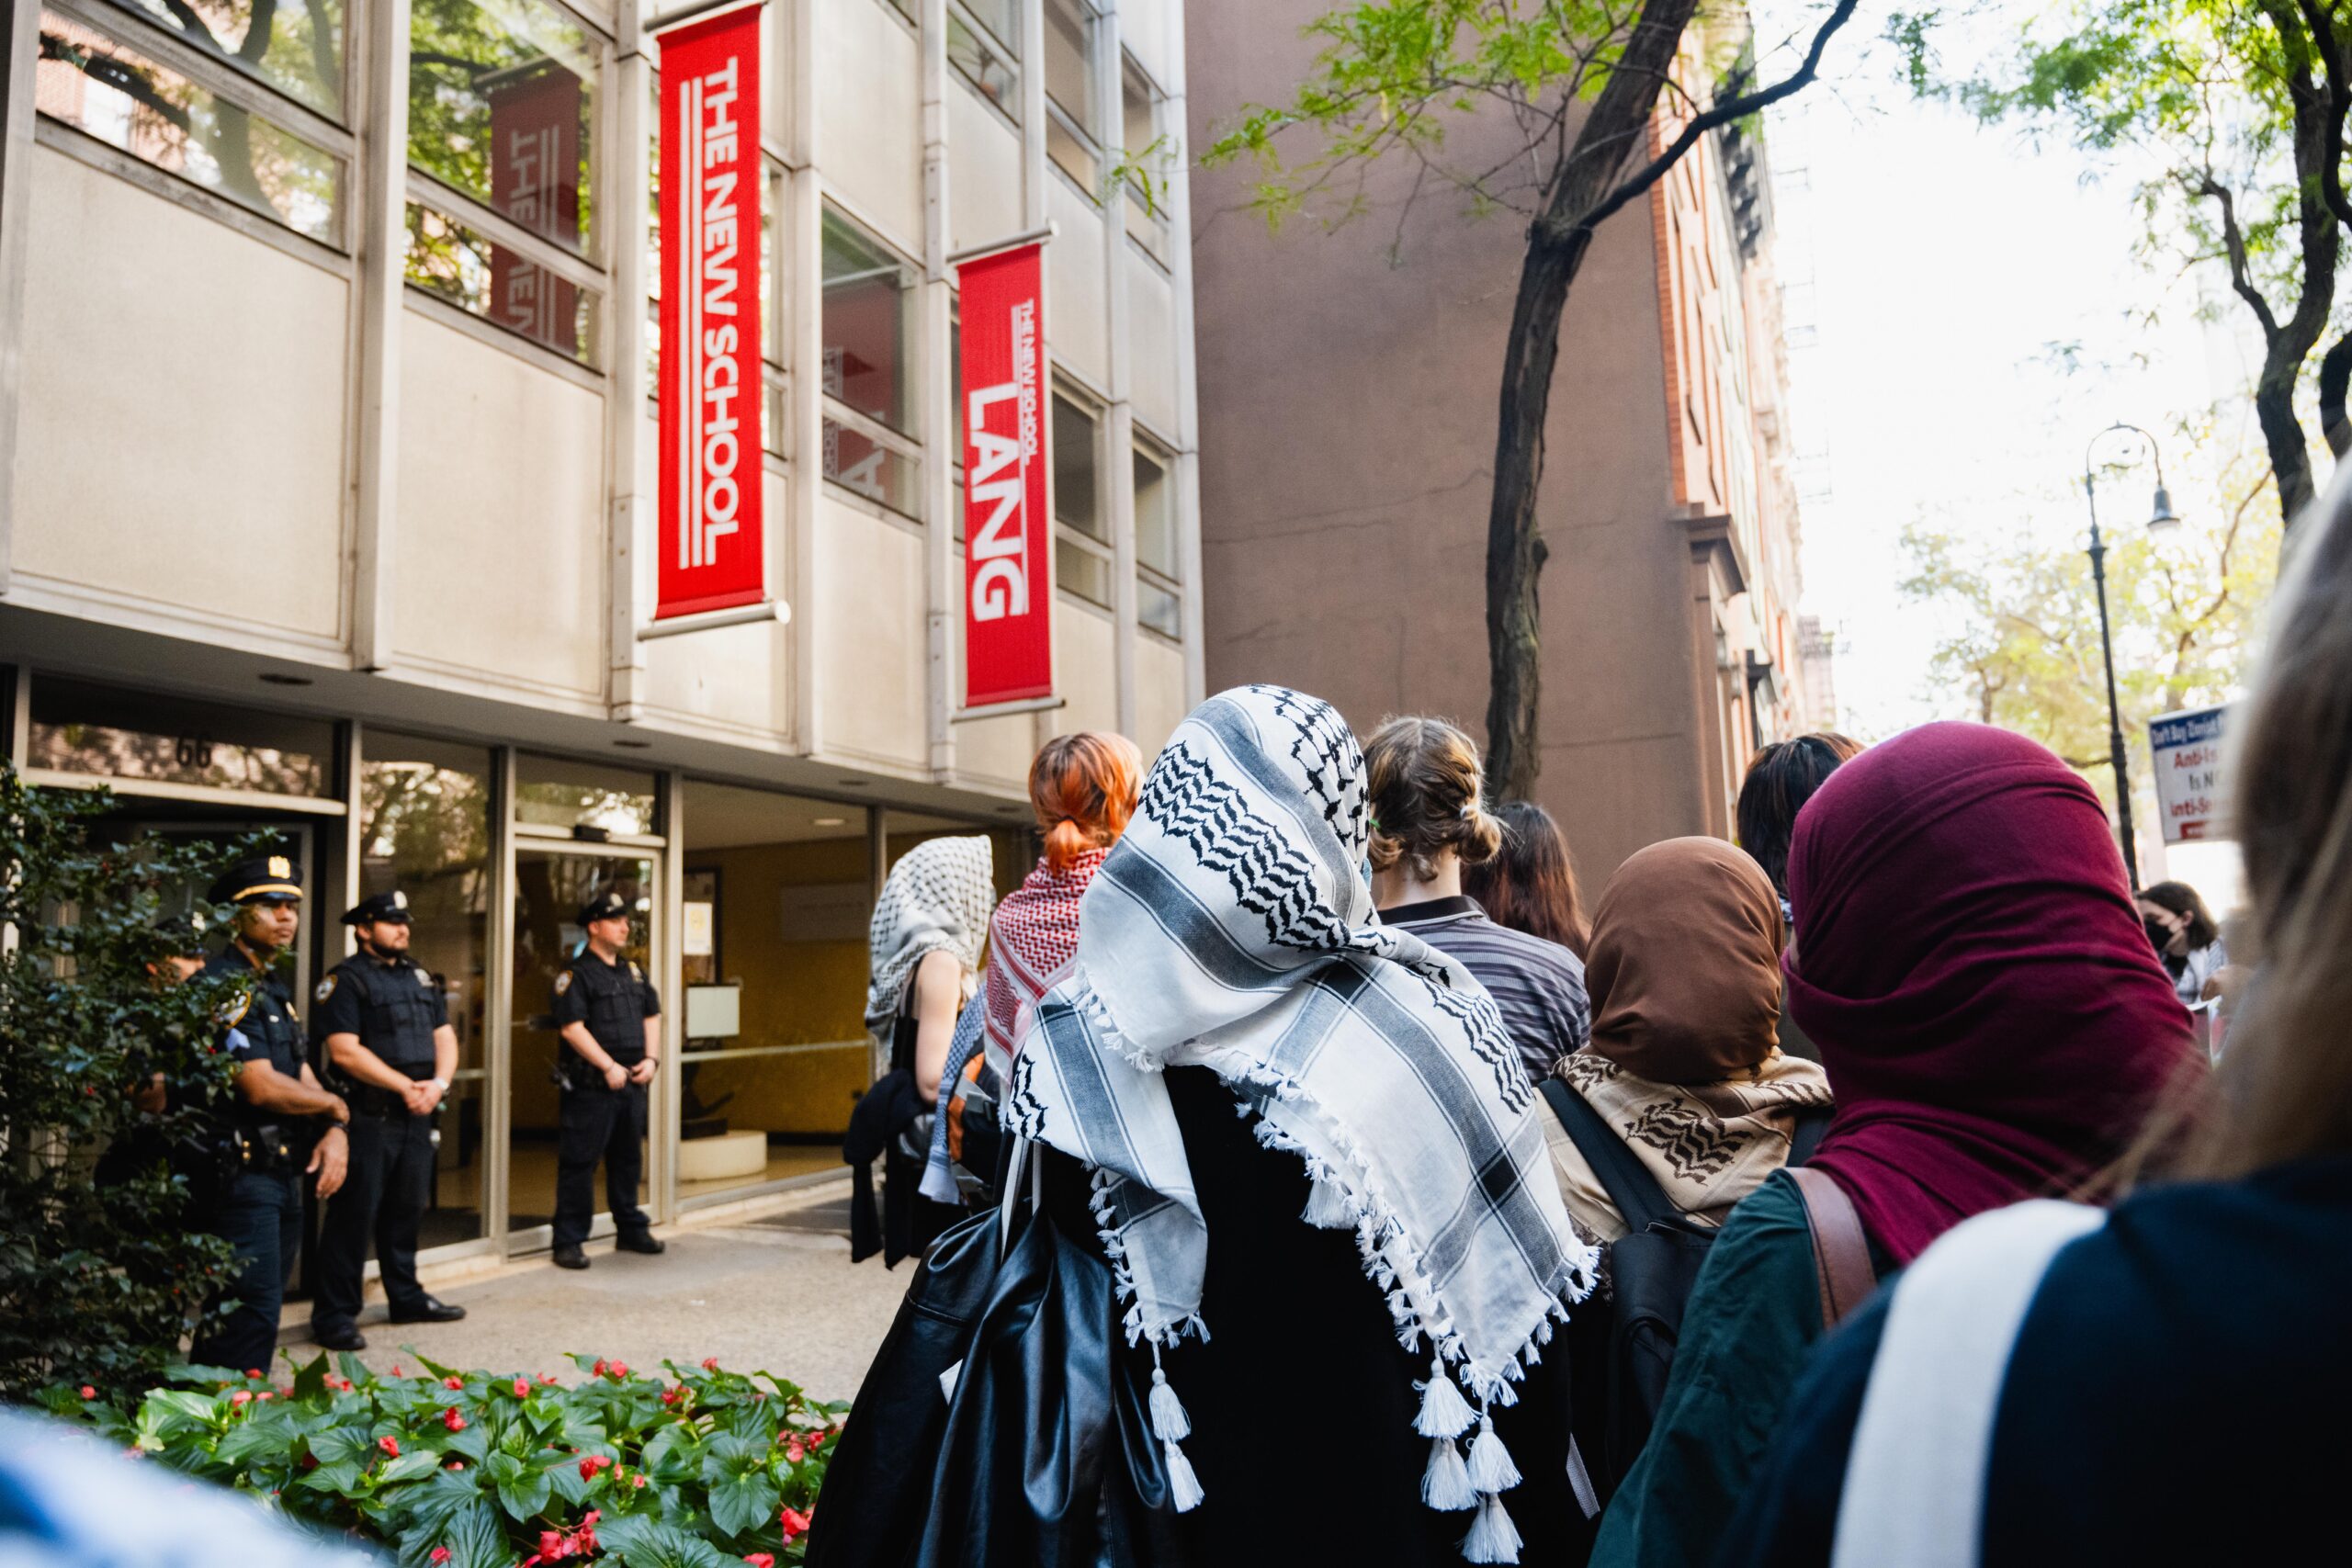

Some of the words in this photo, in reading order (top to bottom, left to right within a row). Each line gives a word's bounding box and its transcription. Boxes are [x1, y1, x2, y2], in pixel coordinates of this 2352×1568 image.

[704, 55, 739, 169] THE
[704, 171, 739, 316] NEW
[1021, 299, 1035, 335] THE
[1022, 336, 1036, 387] NEW
[704, 323, 740, 566] SCHOOL
[1023, 388, 1038, 466] SCHOOL
[968, 381, 1028, 623] LANG
[175, 734, 212, 770] 66
[2174, 746, 2218, 769] Anti-Is
